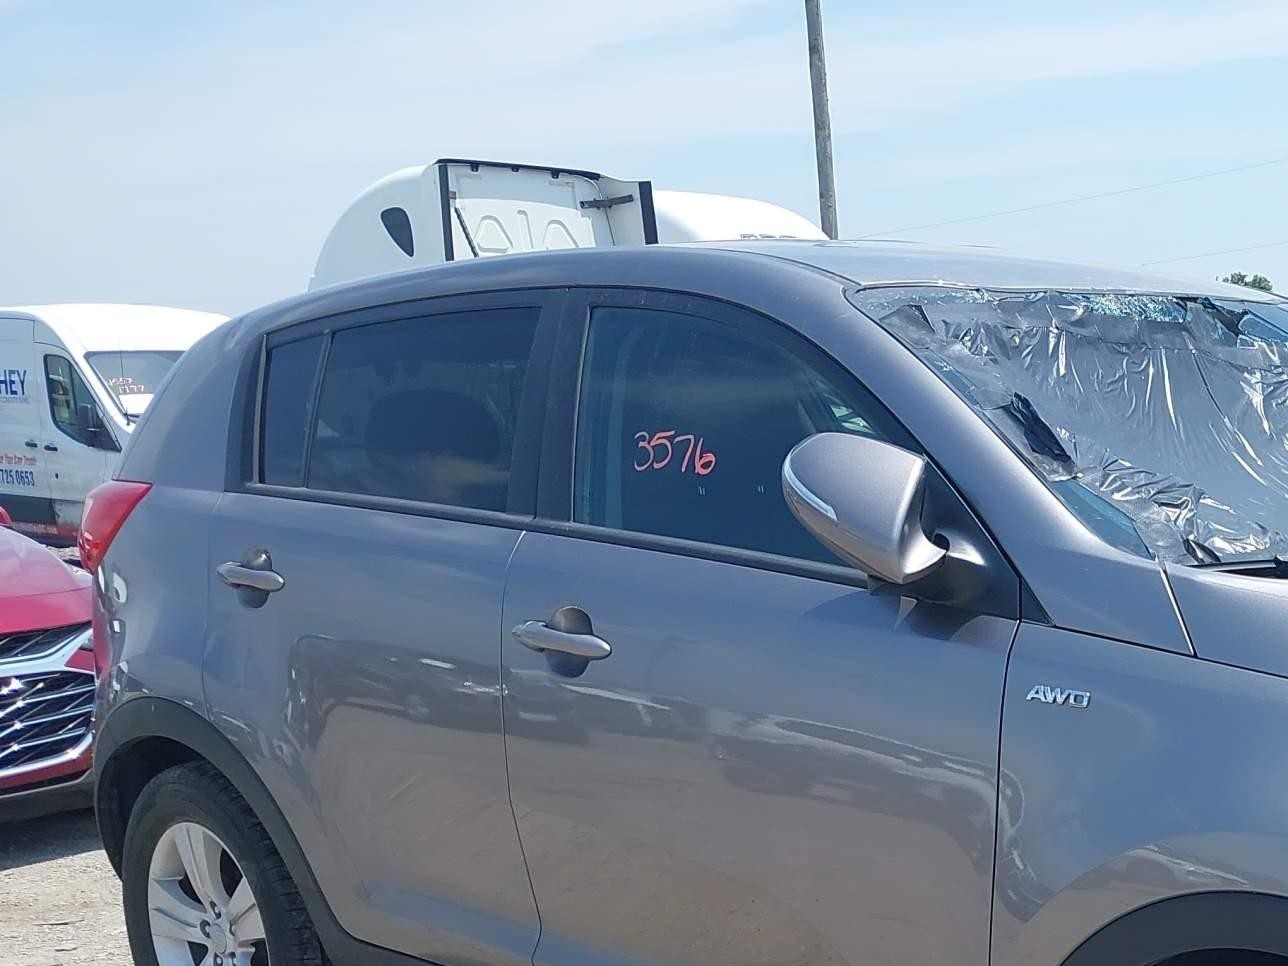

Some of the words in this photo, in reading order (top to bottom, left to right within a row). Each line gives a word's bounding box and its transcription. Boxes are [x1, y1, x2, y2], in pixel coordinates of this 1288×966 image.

[633, 430, 717, 476] 3576
[15, 470, 35, 487] 0653
[1025, 684, 1091, 709] AWD
